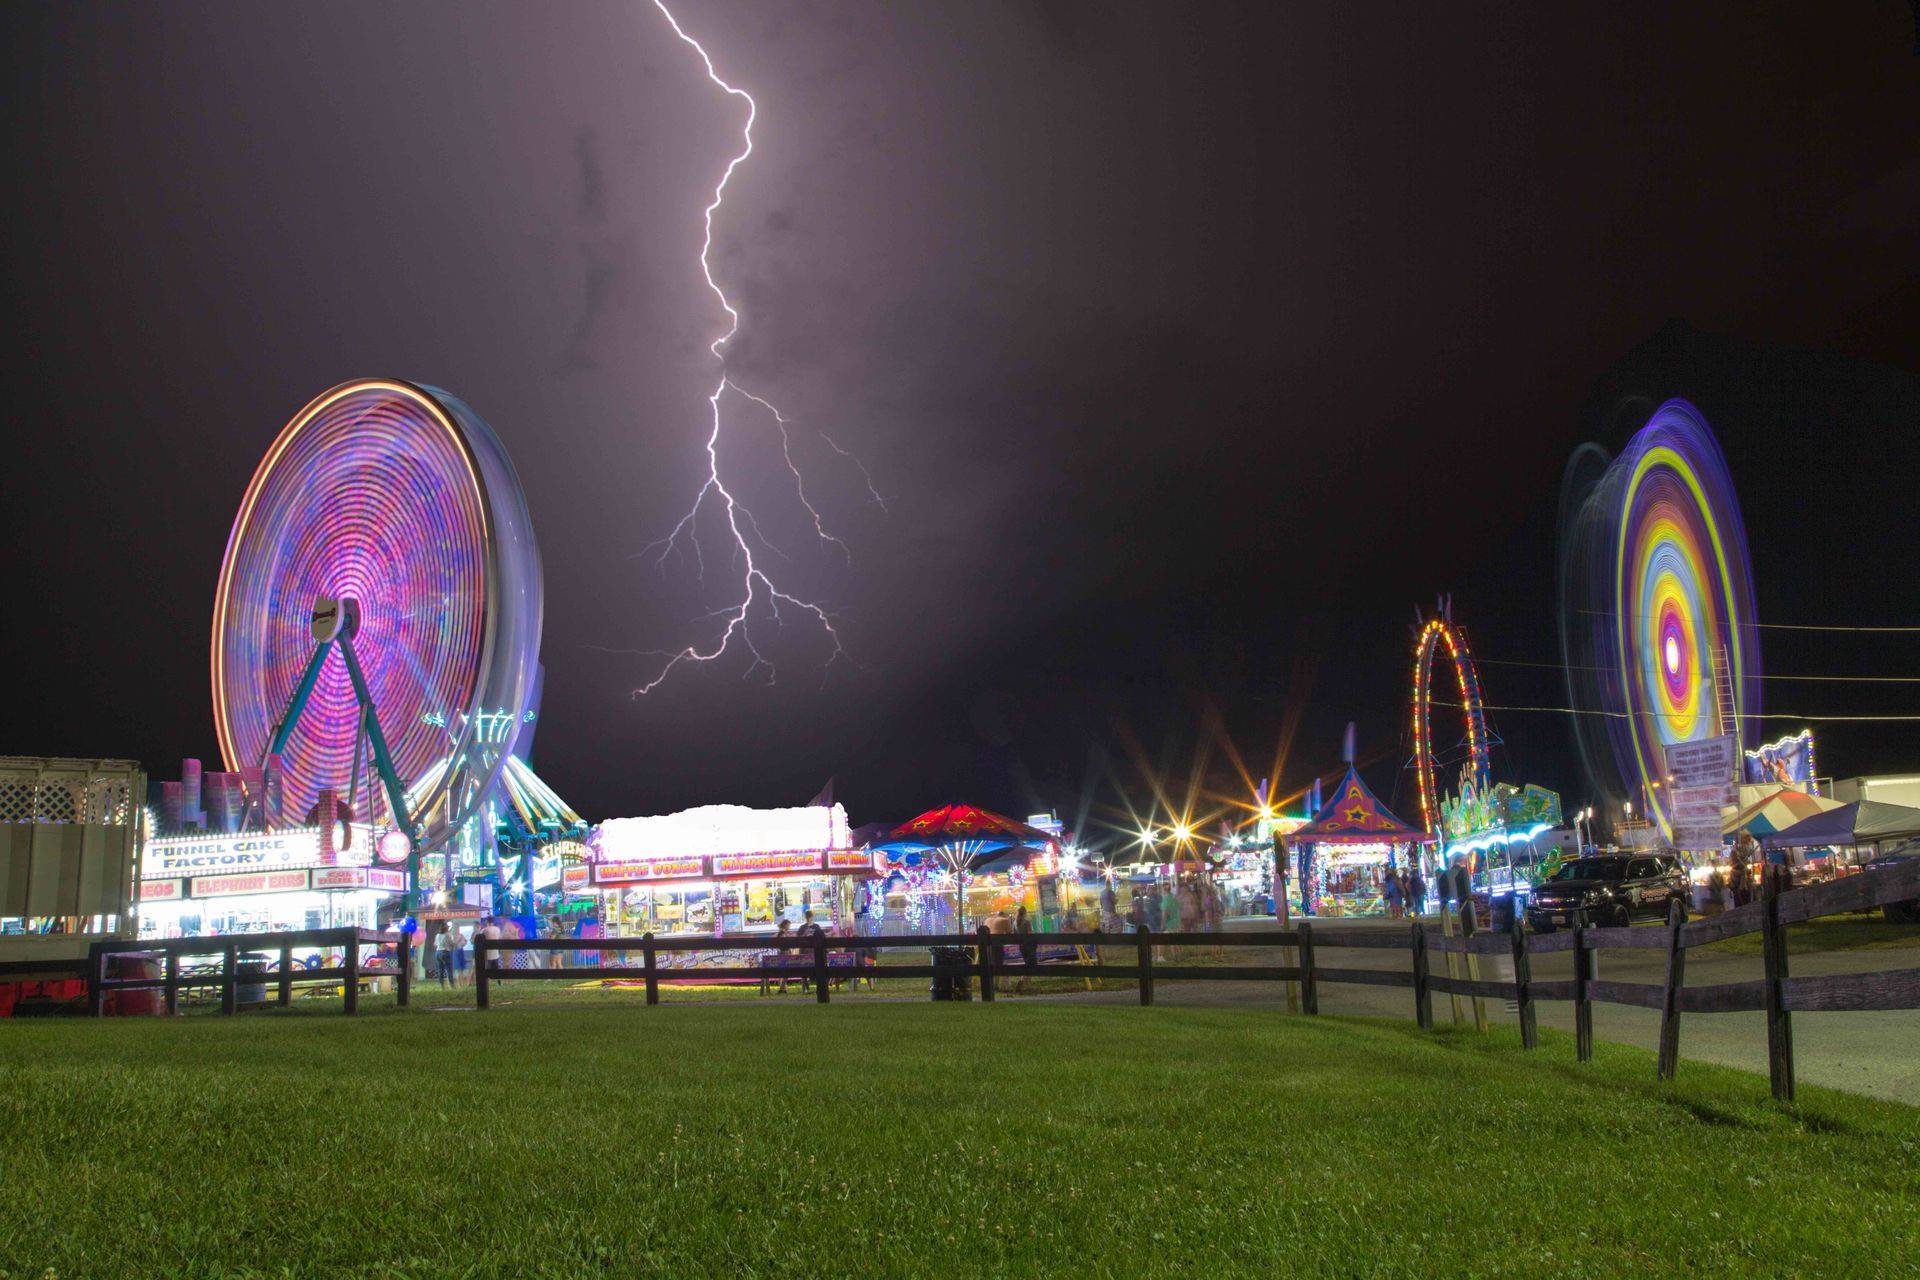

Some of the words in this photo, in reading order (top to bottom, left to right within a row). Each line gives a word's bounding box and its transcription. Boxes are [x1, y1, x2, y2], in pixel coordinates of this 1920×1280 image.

[152, 843, 226, 857] FUNNEL
[233, 840, 285, 851] CAKE
[163, 853, 266, 868] FACTORY
[720, 855, 815, 871] MILKSHAKES
[653, 862, 699, 876] CONES
[196, 875, 266, 894] ELEPHANT
[268, 873, 305, 888] EARS
[425, 911, 449, 919] PHOTO
[451, 910, 477, 918] BOOTH
